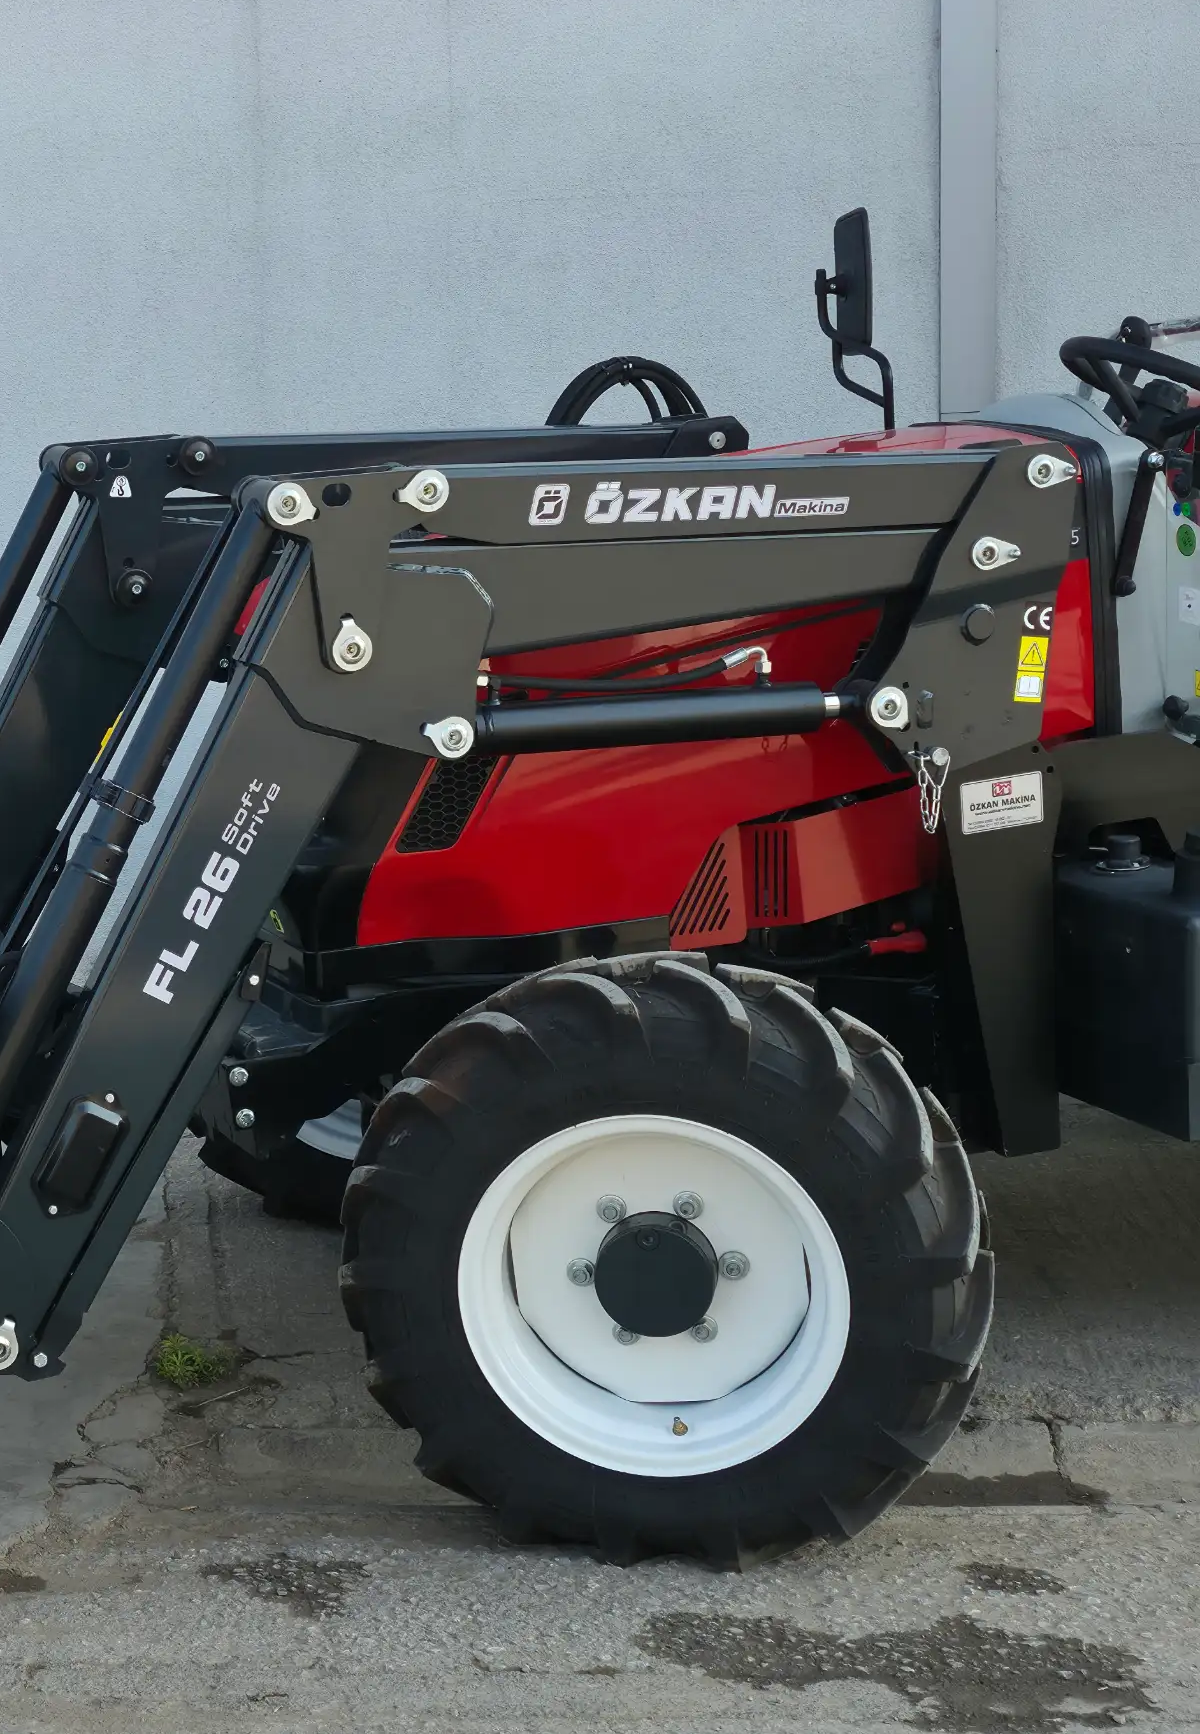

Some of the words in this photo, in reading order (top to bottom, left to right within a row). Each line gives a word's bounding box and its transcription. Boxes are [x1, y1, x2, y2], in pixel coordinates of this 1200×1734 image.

[584, 481, 777, 525] ÖZKAN
[777, 499, 847, 517] Makina
[221, 778, 264, 845] Soft
[235, 782, 281, 856] Drive
[969, 800, 999, 812] ÖZKAN
[142, 940, 200, 1005] FL
[182, 851, 240, 930] 26
